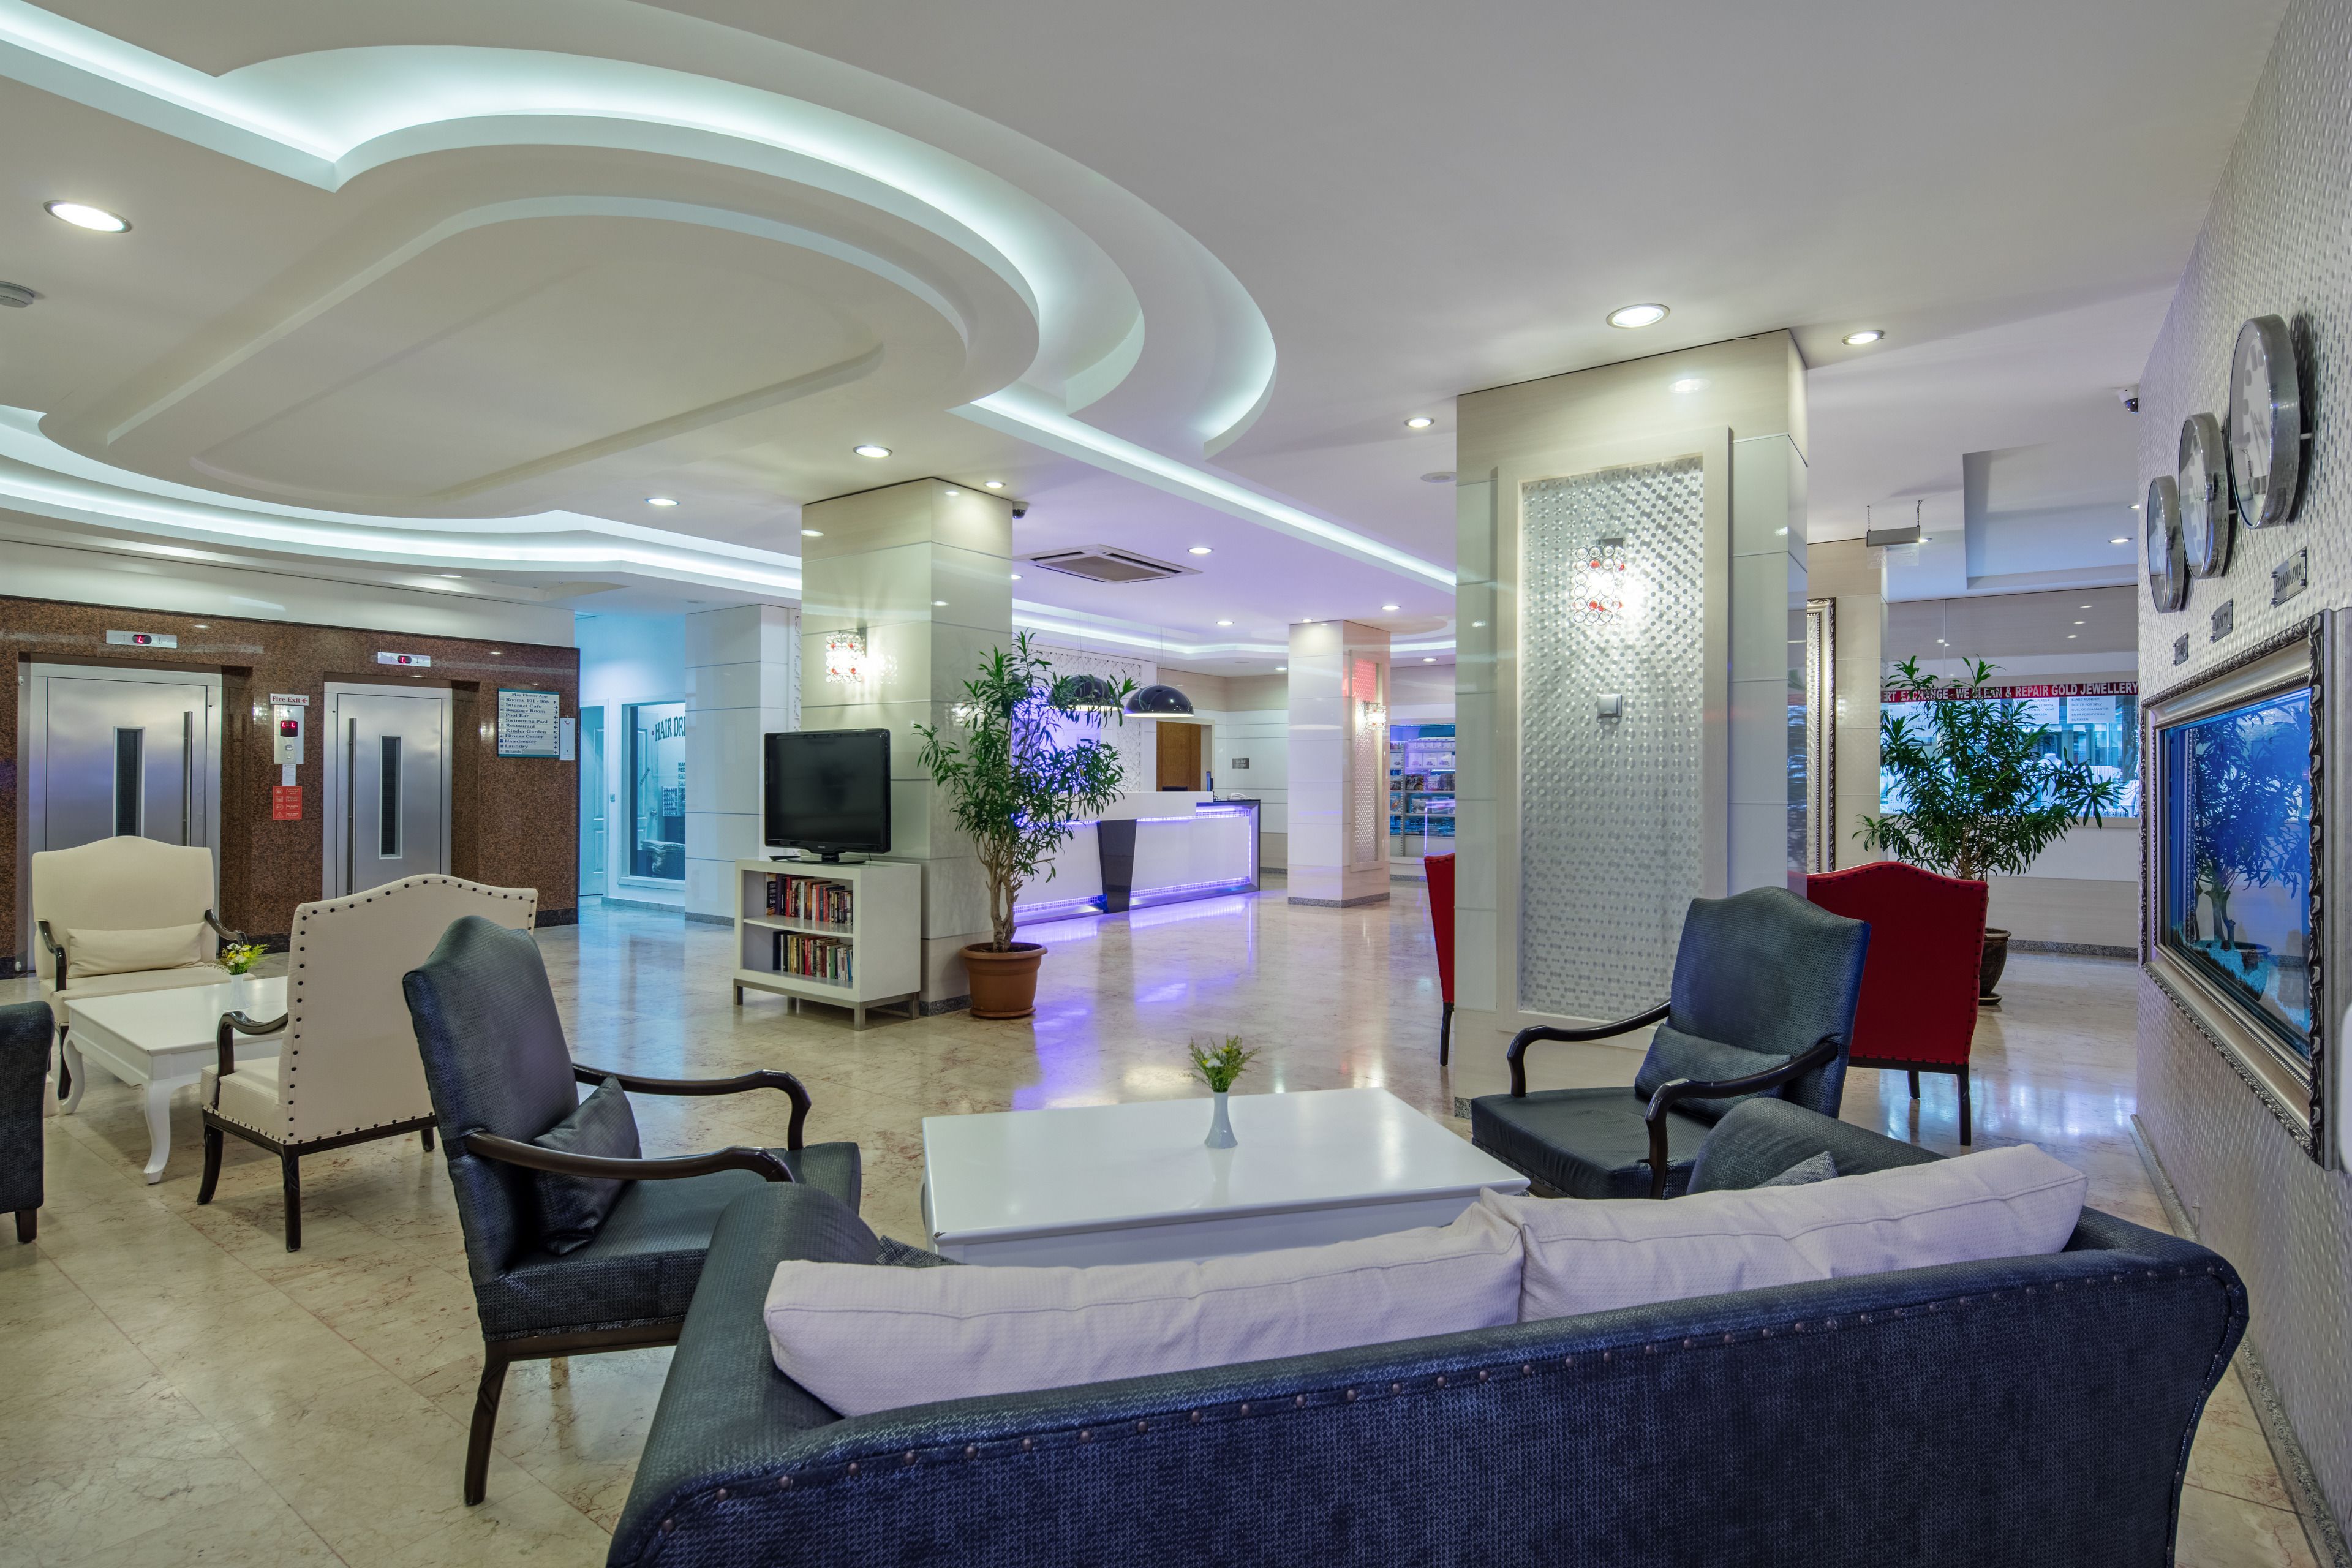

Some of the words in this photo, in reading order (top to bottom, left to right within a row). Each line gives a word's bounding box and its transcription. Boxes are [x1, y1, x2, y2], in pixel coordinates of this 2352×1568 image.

[1956, 688, 1969, 699] WE
[2005, 687, 2012, 698] &
[2015, 685, 2049, 697] REPAIR
[2052, 684, 2077, 696] GOLD
[2080, 682, 2138, 695] JEWELLERY
[655, 718, 672, 741] HAIR
